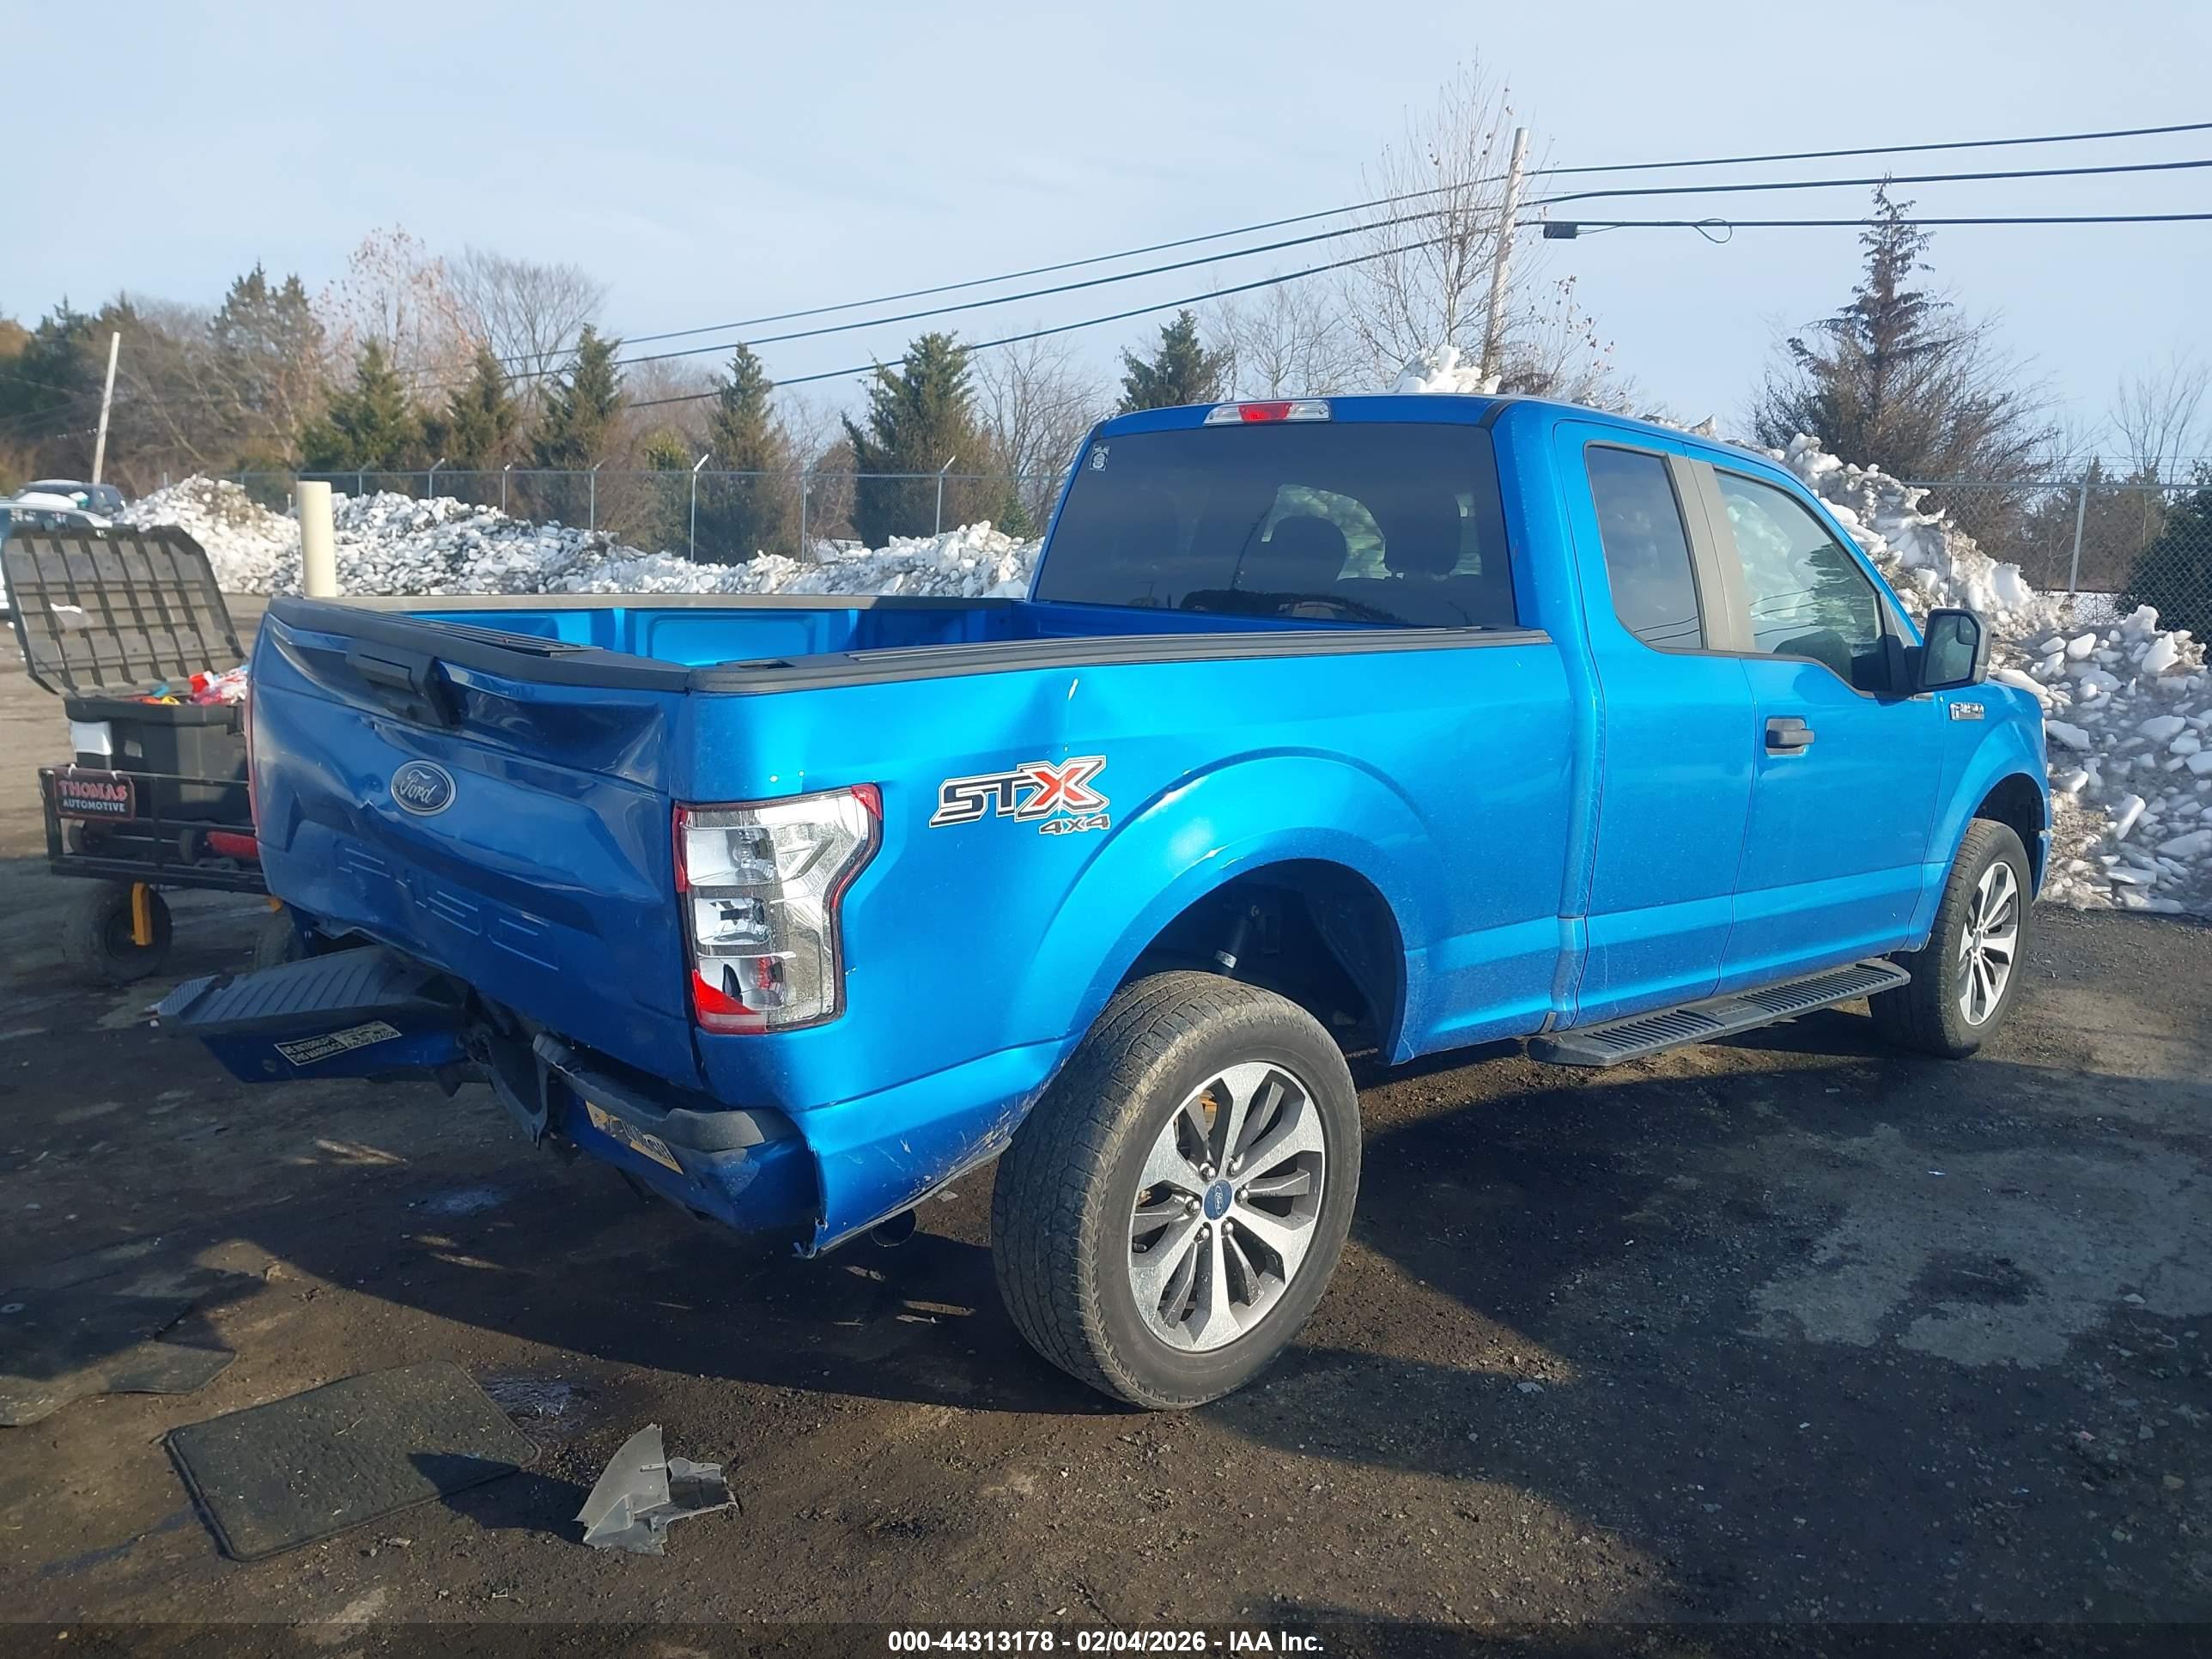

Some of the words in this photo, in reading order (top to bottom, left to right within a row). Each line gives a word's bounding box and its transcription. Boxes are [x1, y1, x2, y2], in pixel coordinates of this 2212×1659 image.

[58, 780, 128, 802] THOMAS
[400, 769, 438, 804] Ford
[929, 756, 1109, 828] STX
[63, 798, 126, 812] AUTOMOTIVE
